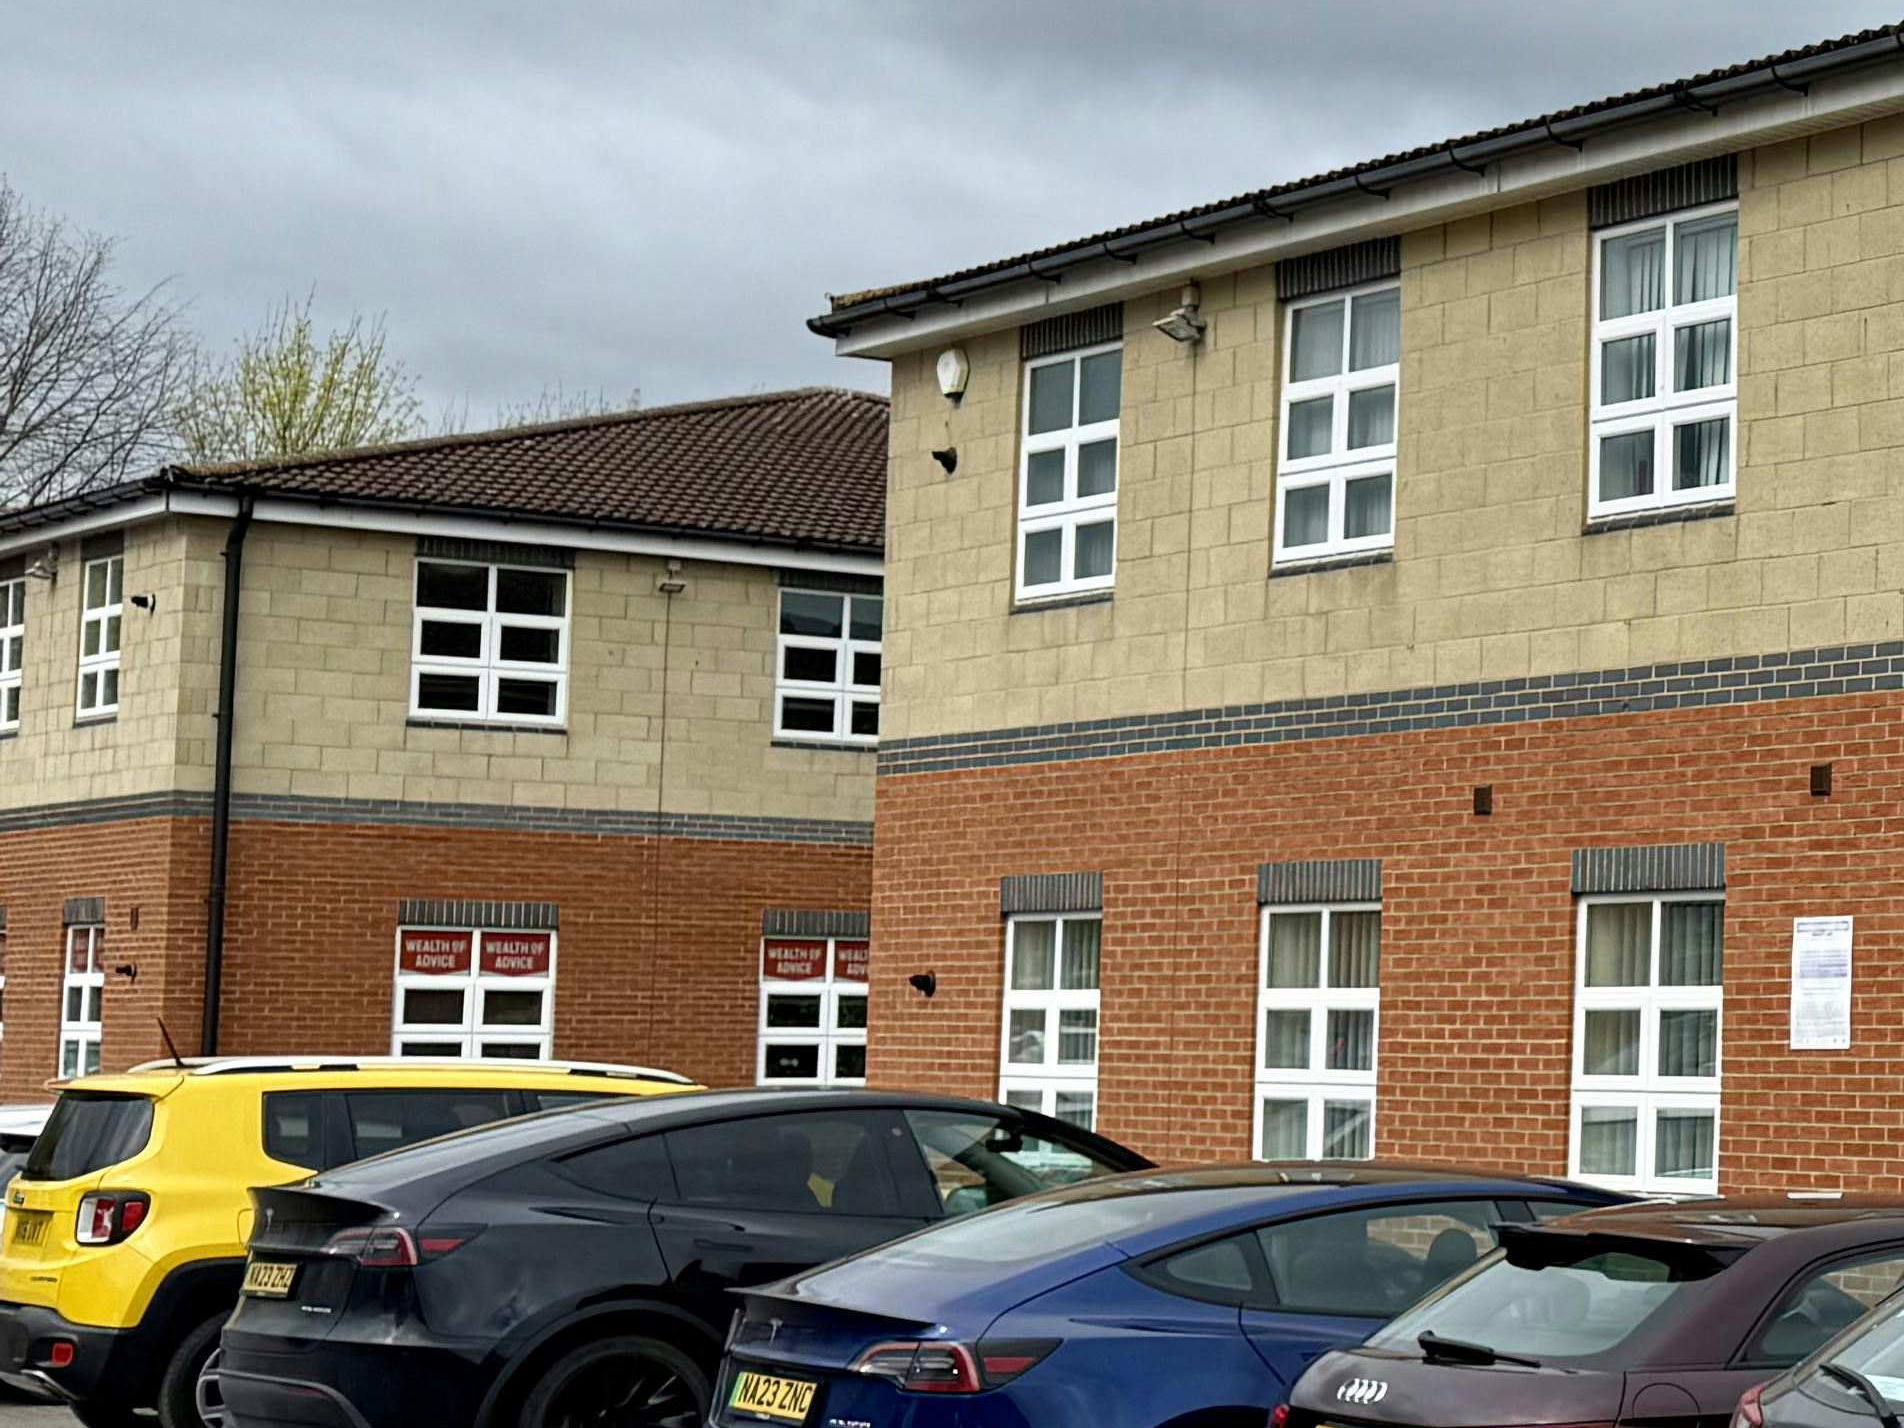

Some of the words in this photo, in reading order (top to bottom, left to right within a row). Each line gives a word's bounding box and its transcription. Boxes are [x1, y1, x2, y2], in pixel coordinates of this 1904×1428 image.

[405, 939, 449, 953] WEALTH
[451, 940, 468, 953] OF
[485, 941, 529, 954] WEALTH
[530, 942, 546, 955] OF
[415, 955, 456, 969] ADVICE
[495, 956, 534, 969] ADVICE
[738, 1372, 780, 1407] NA23
[778, 1381, 813, 1413] ZNC
